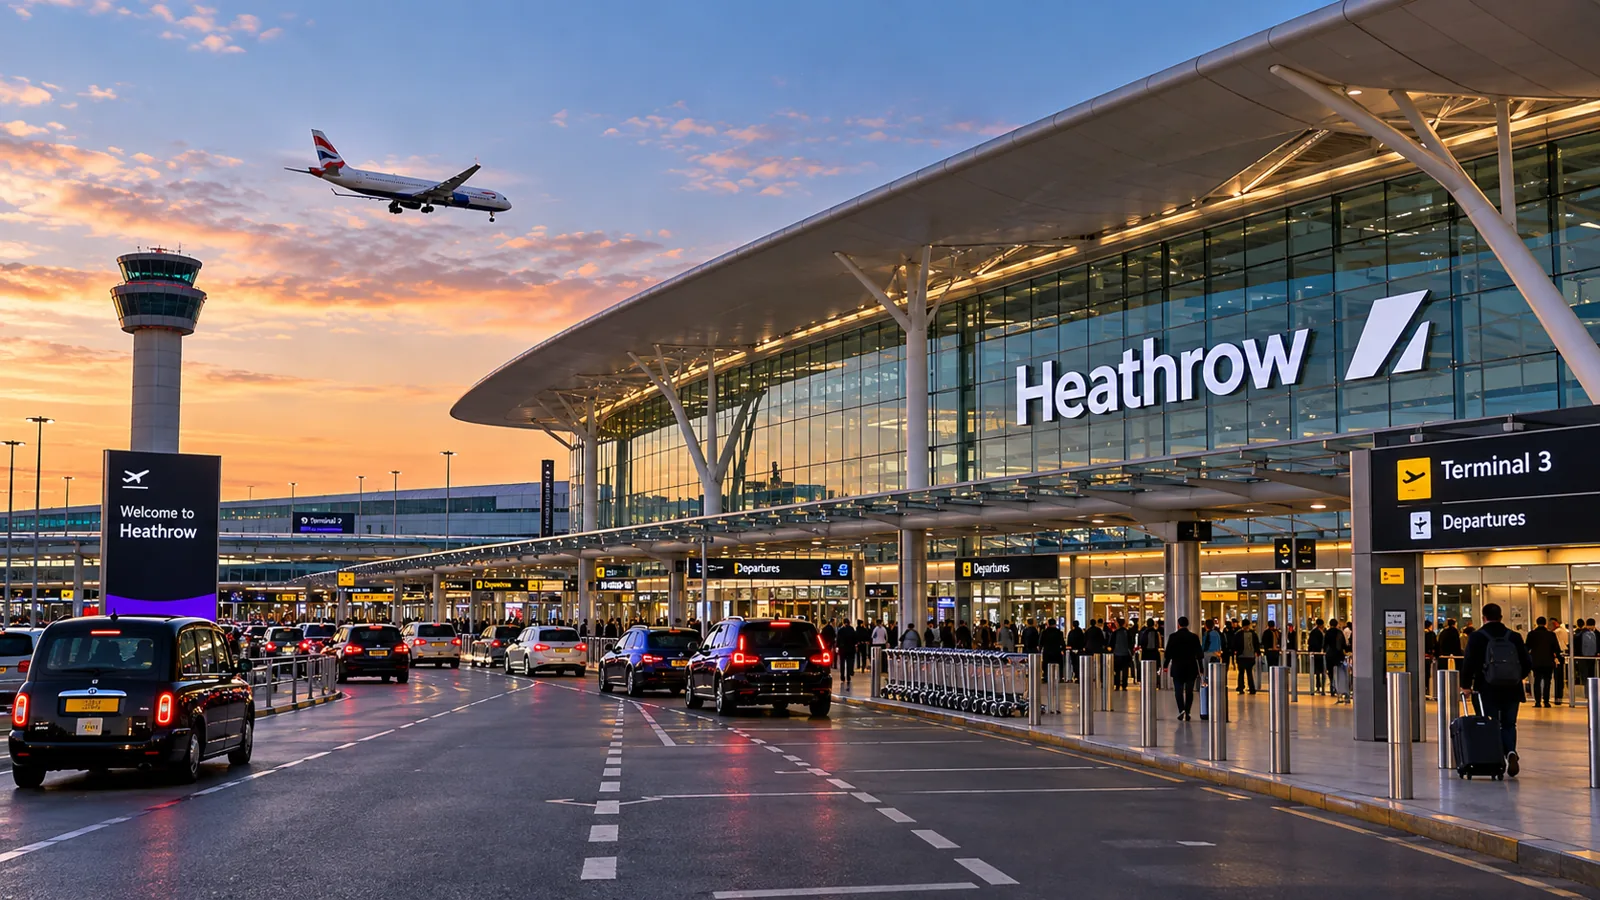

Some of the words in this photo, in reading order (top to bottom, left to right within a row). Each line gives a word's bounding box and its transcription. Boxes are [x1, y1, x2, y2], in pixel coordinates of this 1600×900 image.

[1016, 328, 1311, 426] Heathrow
[1440, 452, 1530, 480] Terminal
[1538, 450, 1553, 472] 3
[120, 504, 177, 519] Welcome
[181, 507, 195, 519] to
[1442, 511, 1527, 533] Departures
[119, 523, 198, 539] Heathrow
[735, 562, 781, 576] Departures
[973, 562, 1011, 577] Departures
